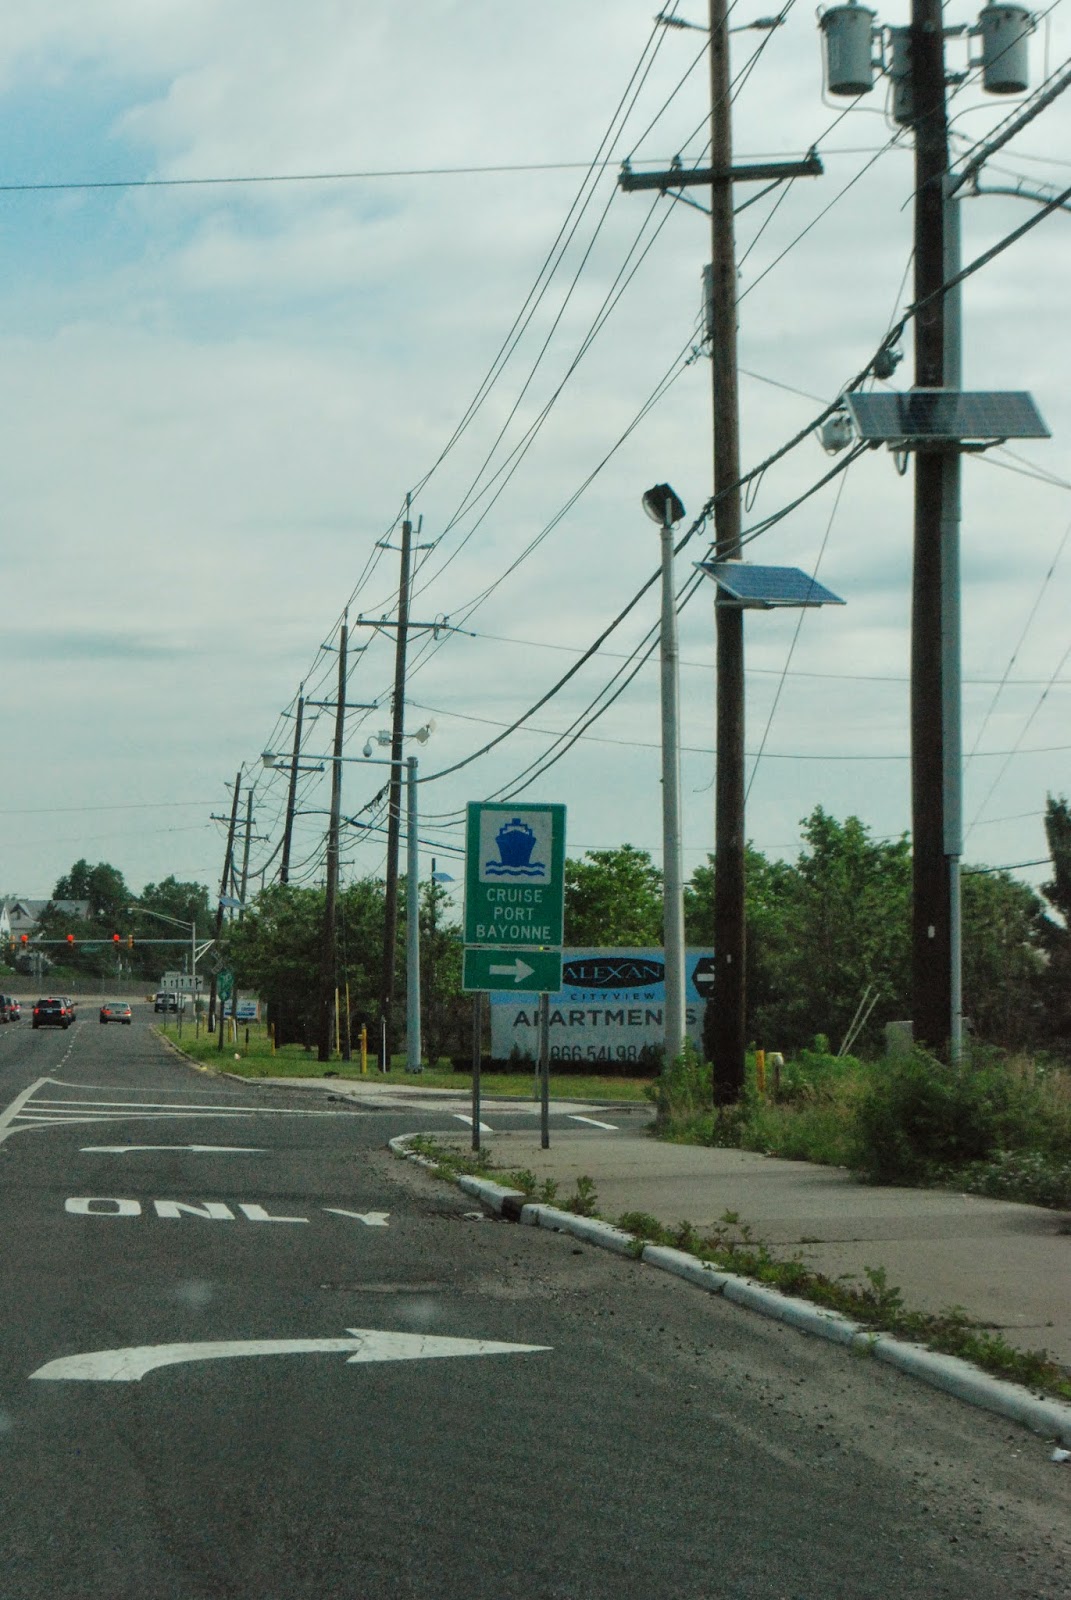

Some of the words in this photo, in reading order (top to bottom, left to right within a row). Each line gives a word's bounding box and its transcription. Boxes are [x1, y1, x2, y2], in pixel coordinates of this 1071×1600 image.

[486, 888, 543, 903] CRUISE
[494, 906, 535, 920] PORT
[476, 924, 551, 940] BAYONNE
[563, 962, 661, 983] ALEXAN
[570, 993, 656, 1001] CITYVIEW
[513, 1009, 698, 1027] APARTMENS
[64, 1196, 391, 1227] ONLY
